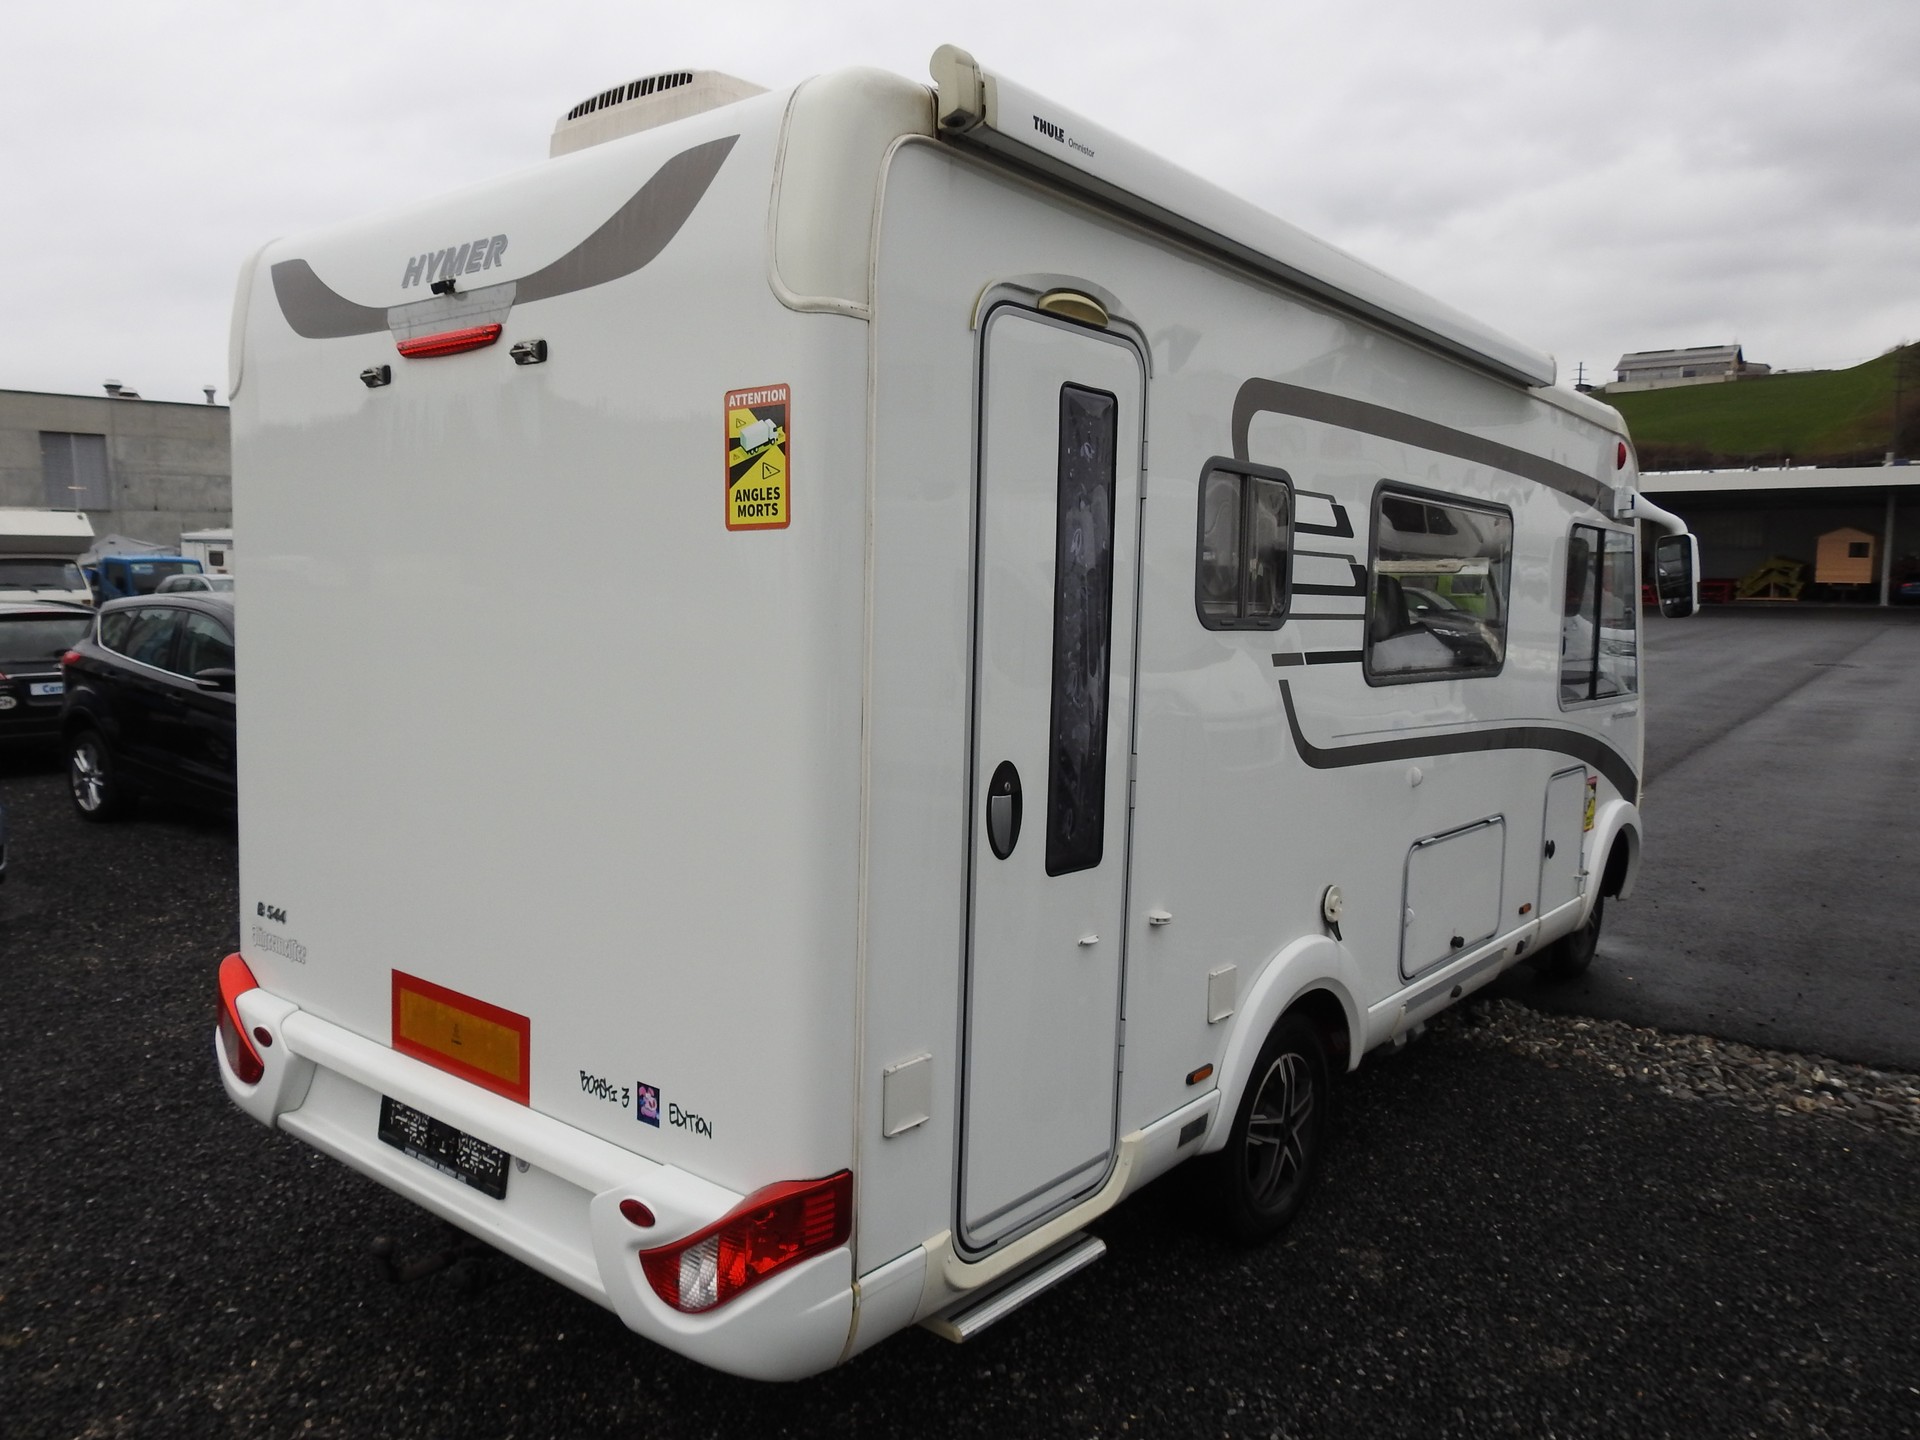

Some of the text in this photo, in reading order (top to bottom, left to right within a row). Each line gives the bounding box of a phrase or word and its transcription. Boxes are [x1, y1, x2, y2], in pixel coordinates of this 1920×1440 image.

[1033, 115, 1095, 158] THULE Omnistor
[401, 233, 508, 289] HYMER
[728, 388, 787, 407] ATTENTION
[734, 486, 781, 503] ANGLES
[737, 502, 779, 523] MORTS
[266, 905, 287, 925] 544
[621, 1086, 630, 1109] 3
[668, 1102, 712, 1140] EDITION
